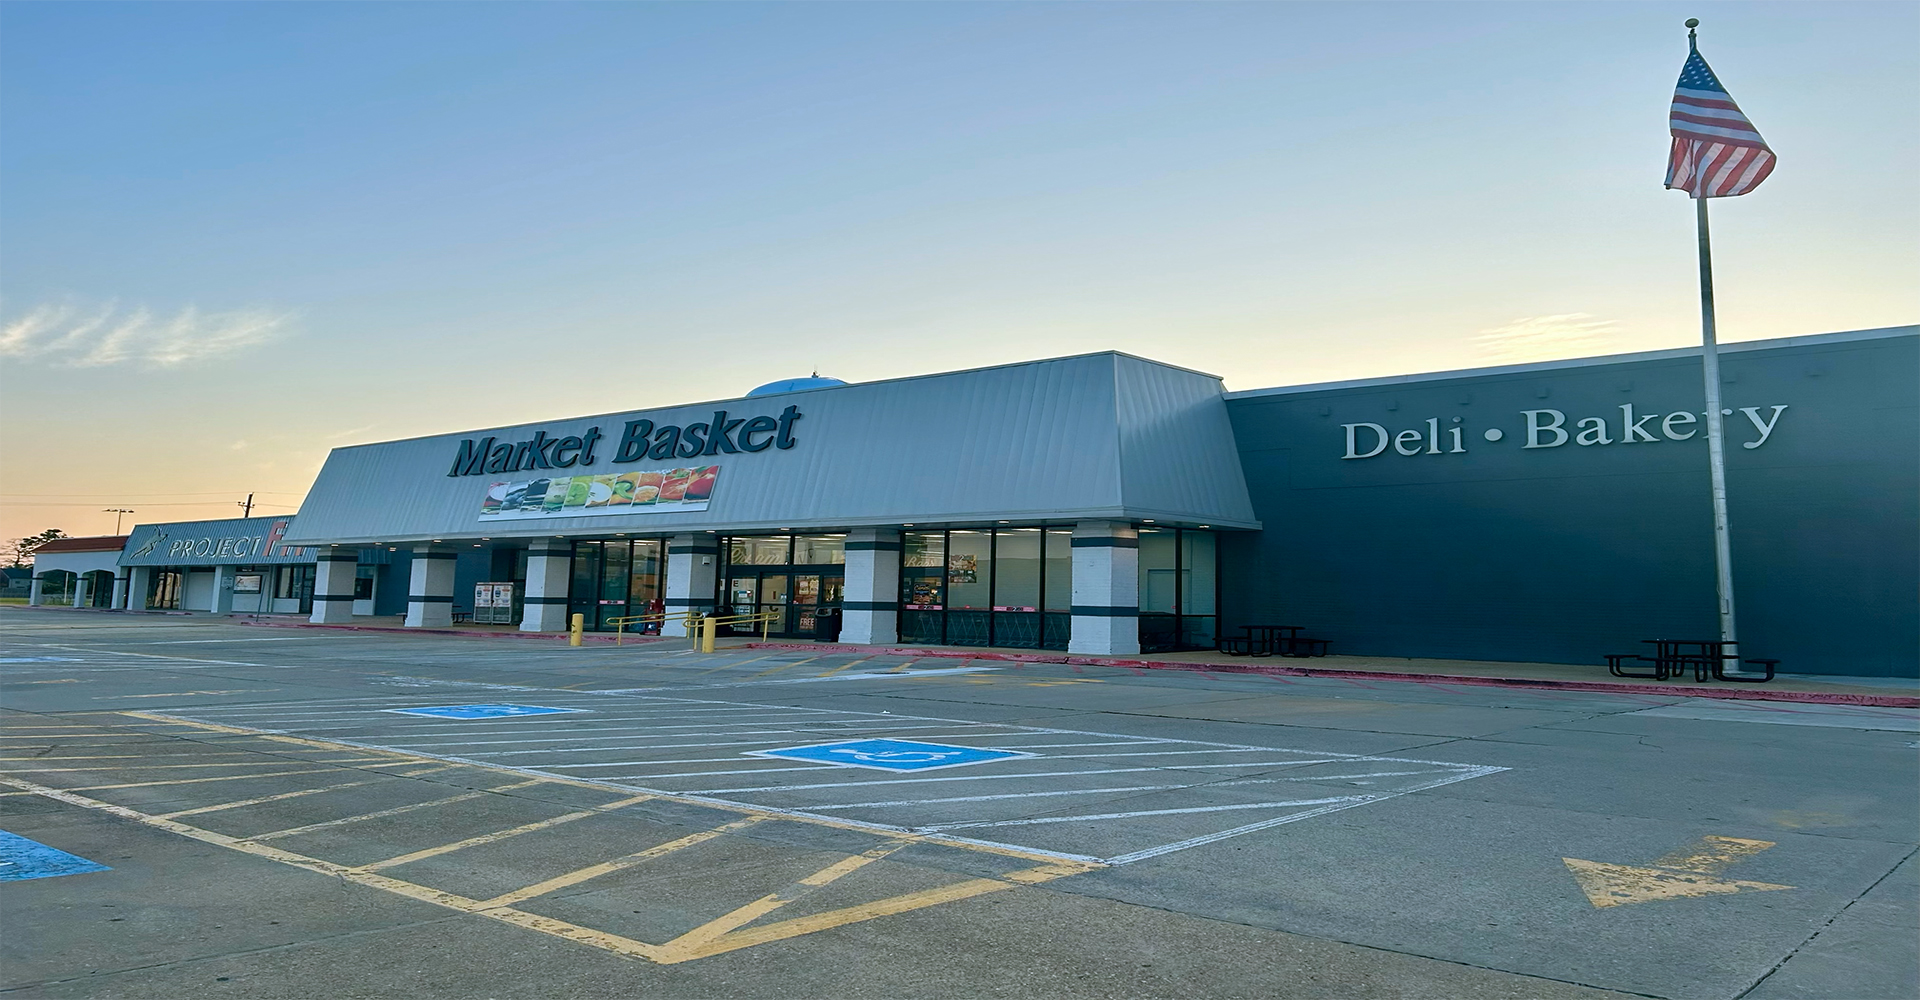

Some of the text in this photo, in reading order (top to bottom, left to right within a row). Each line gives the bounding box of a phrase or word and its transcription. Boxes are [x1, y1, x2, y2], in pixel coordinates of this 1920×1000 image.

[446, 404, 802, 477] Market Basket
[1341, 416, 1467, 459] Deli
[169, 536, 262, 557] PROJECT
[800, 617, 815, 626] FREE
